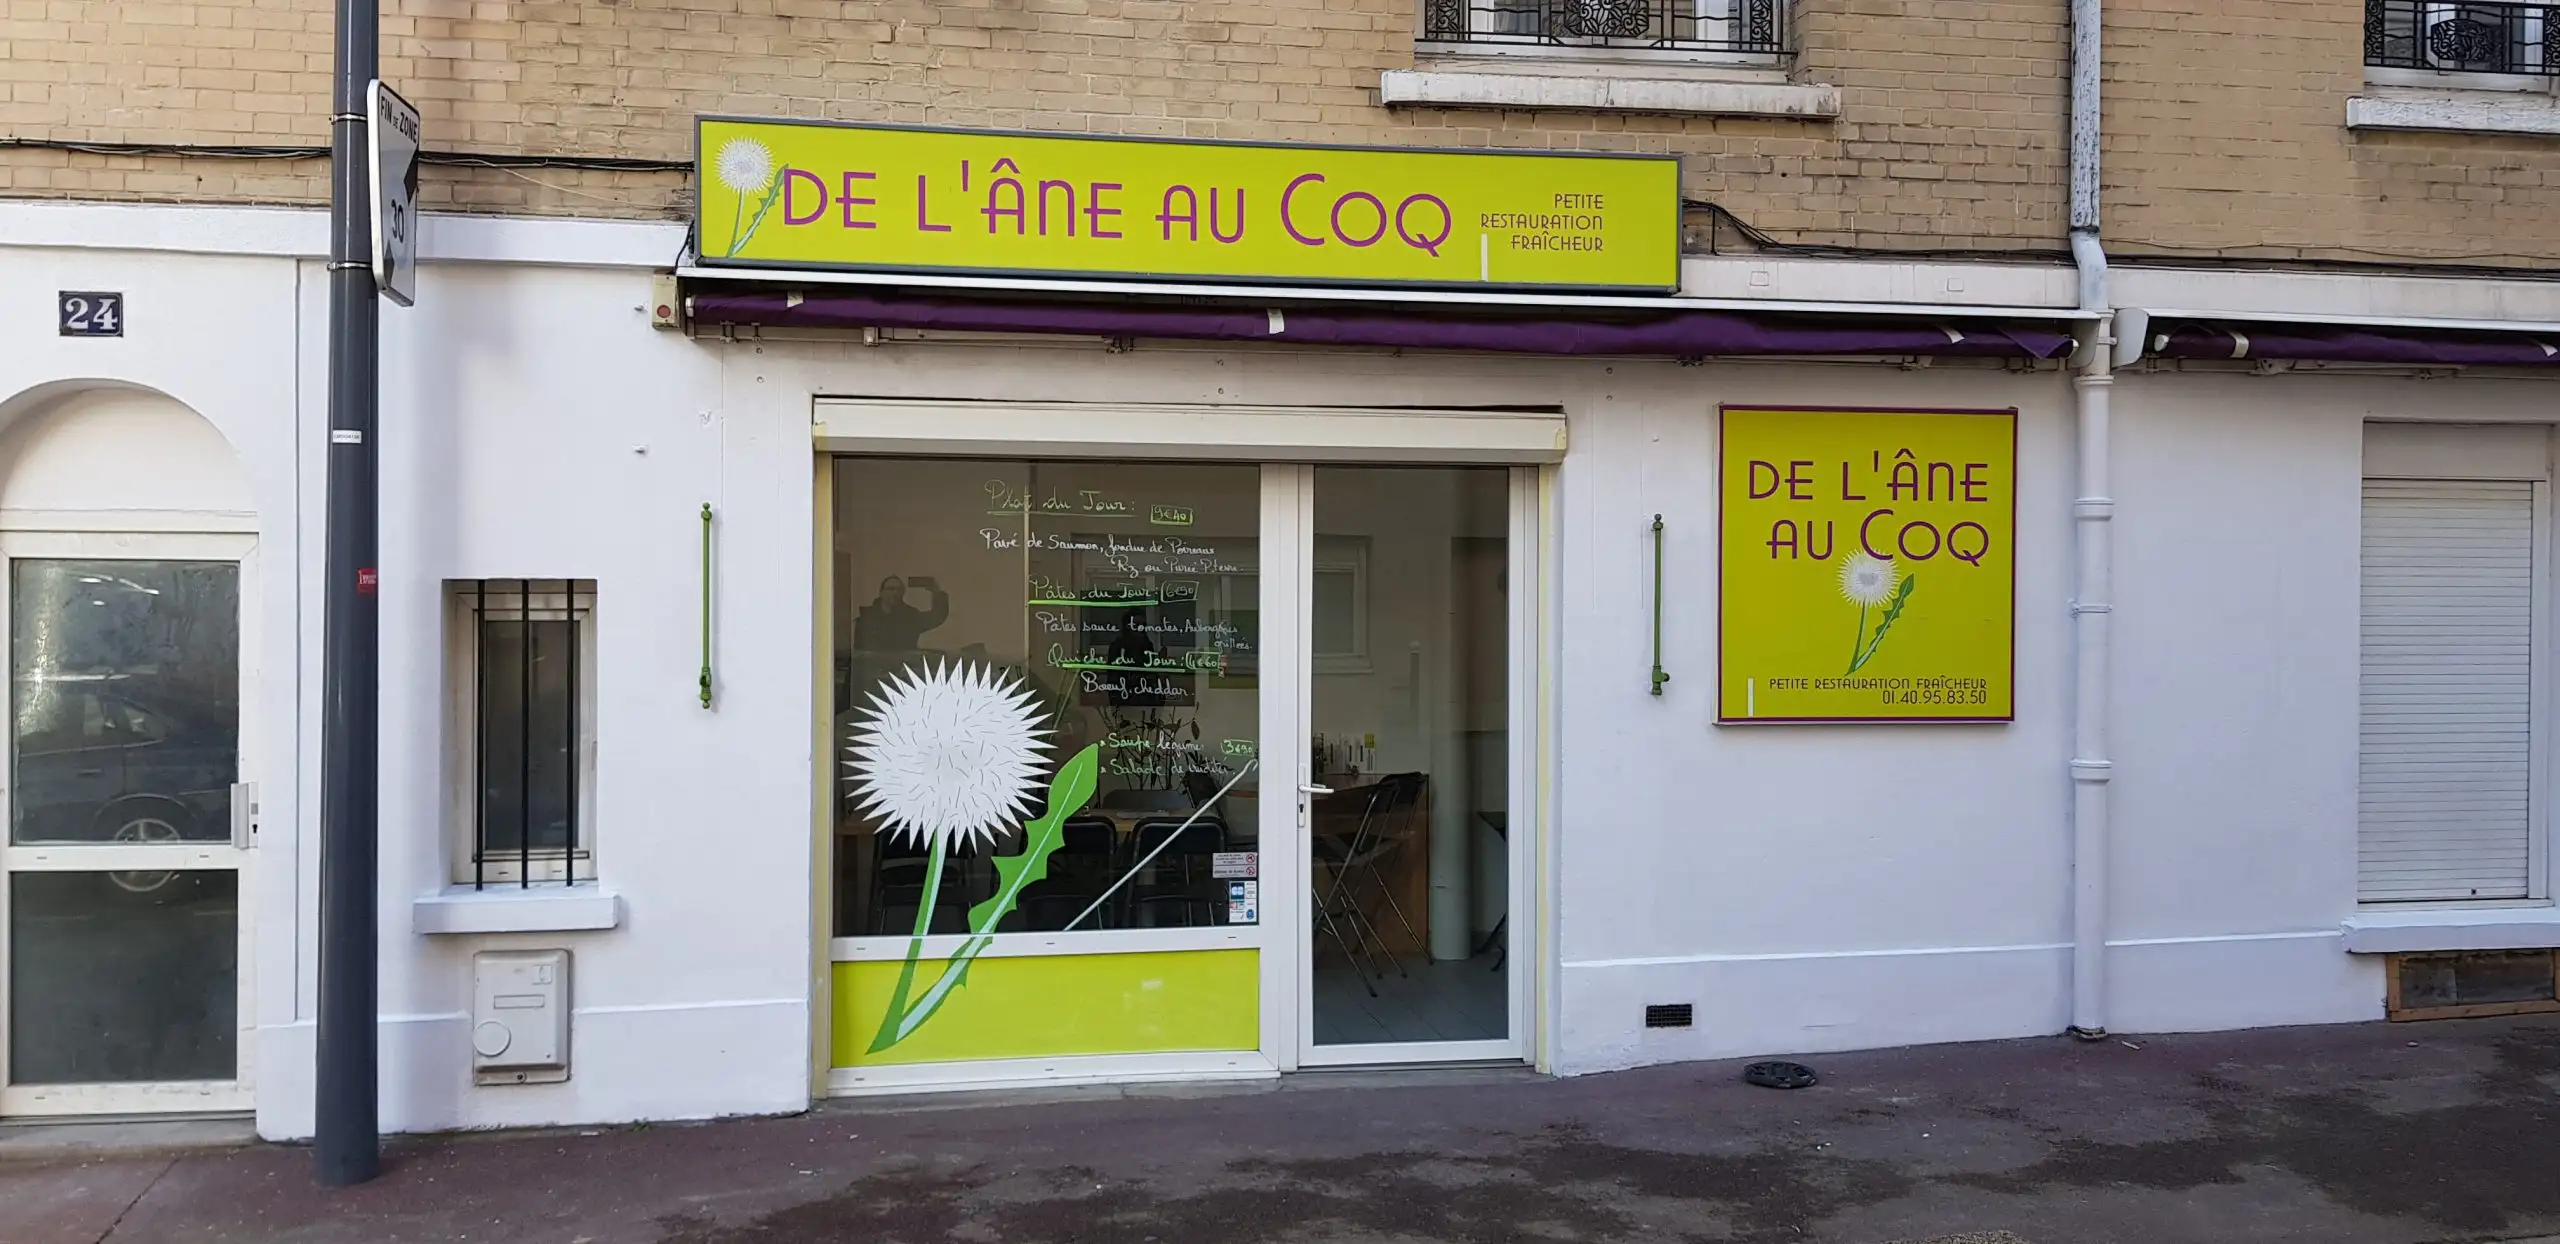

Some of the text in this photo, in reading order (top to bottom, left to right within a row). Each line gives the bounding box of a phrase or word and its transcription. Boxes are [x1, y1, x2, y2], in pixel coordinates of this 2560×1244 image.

[381, 96, 392, 124] FIN
[400, 112, 417, 144] ZONE
[784, 157, 1452, 258] DE L'ÂNE AU COQ
[1555, 193, 1604, 210] PETITE
[391, 199, 404, 243] 30
[1481, 213, 1603, 231] RESTAURATION
[1511, 231, 1604, 252] FRAÎCHEUR
[65, 297, 118, 329] 24
[1748, 448, 1988, 502] DE L'ÂNE
[985, 479, 1032, 509] Plat
[1043, 486, 1072, 510] du
[979, 528, 1020, 550] Pavé
[1027, 532, 1044, 548] de
[1104, 534, 1147, 557] fondue
[1150, 540, 1165, 553] de
[1766, 508, 1990, 567] AU COQ
[1145, 564, 1162, 573] ou
[1029, 574, 1075, 599] Pâtes
[1083, 582, 1112, 598] du
[1035, 611, 1076, 633] Pâtes
[1082, 621, 1119, 632] sauce
[1047, 643, 1106, 667] Quiche
[1112, 648, 1135, 664] du
[1769, 674, 1987, 690] PETITE RESTAURATION FRAÎCHEUR
[1882, 690, 1987, 705] 01.40.95.83.50
[1108, 733, 1152, 751] Soupe
[1110, 758, 1166, 775] Salade
[1171, 757, 1183, 774] de
